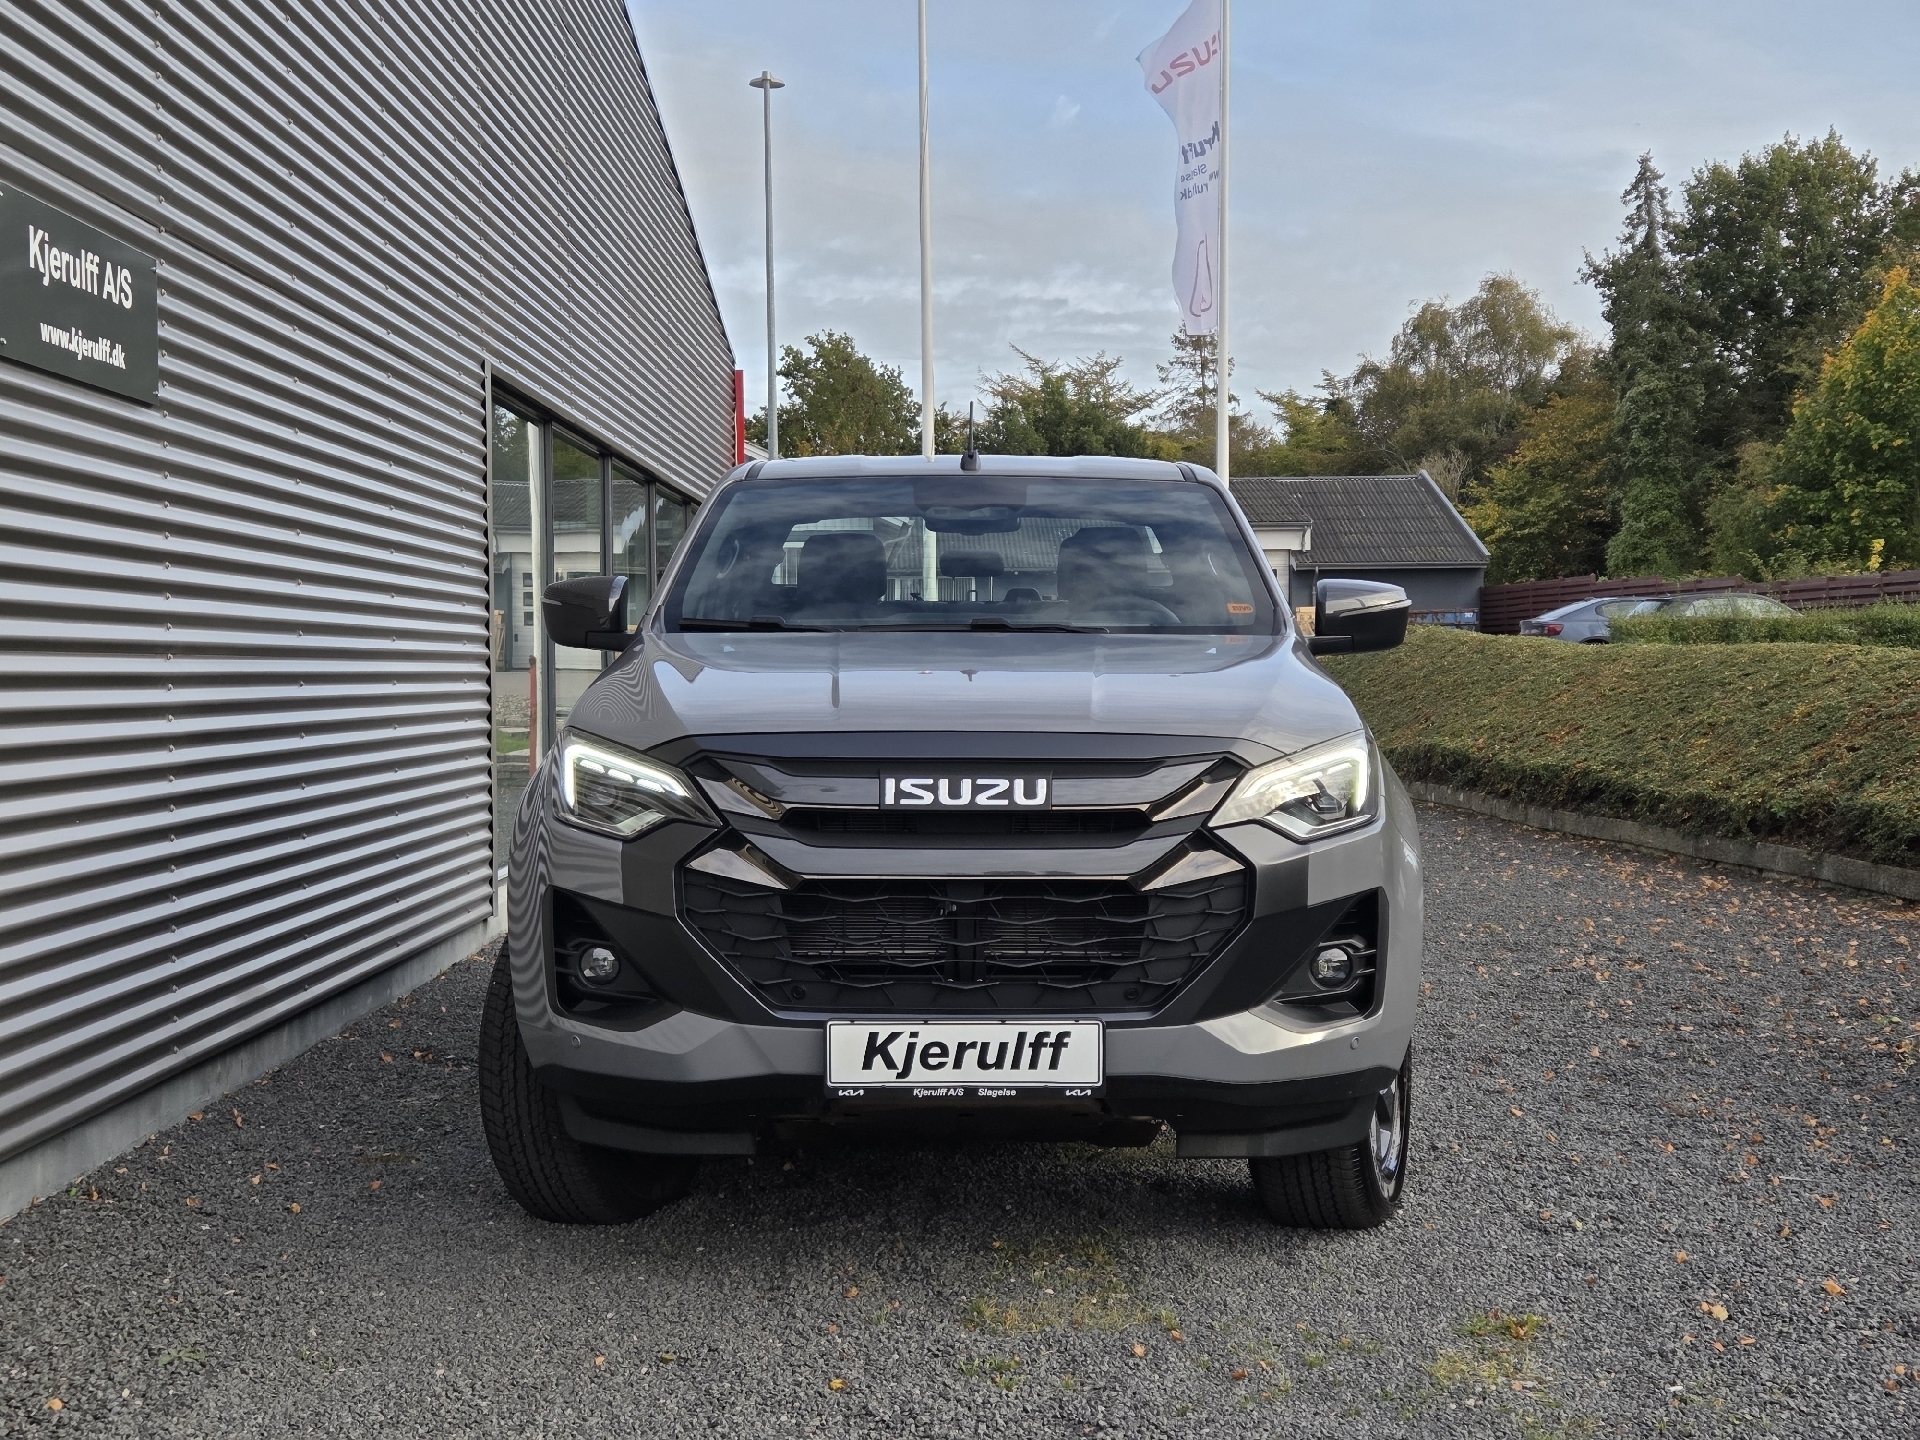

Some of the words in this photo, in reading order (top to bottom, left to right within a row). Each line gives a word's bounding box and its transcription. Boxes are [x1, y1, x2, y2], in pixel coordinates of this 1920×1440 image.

[28, 224, 100, 296] Kjerulff
[102, 261, 133, 309] A/S
[39, 322, 126, 370] www.kjerulff.dk
[884, 777, 1047, 806] ISUZU
[861, 1031, 1072, 1080] Kjerulff
[913, 1088, 948, 1098] Kjerulff
[948, 1088, 965, 1096] A/S
[977, 1088, 1017, 1098] Slagelse
